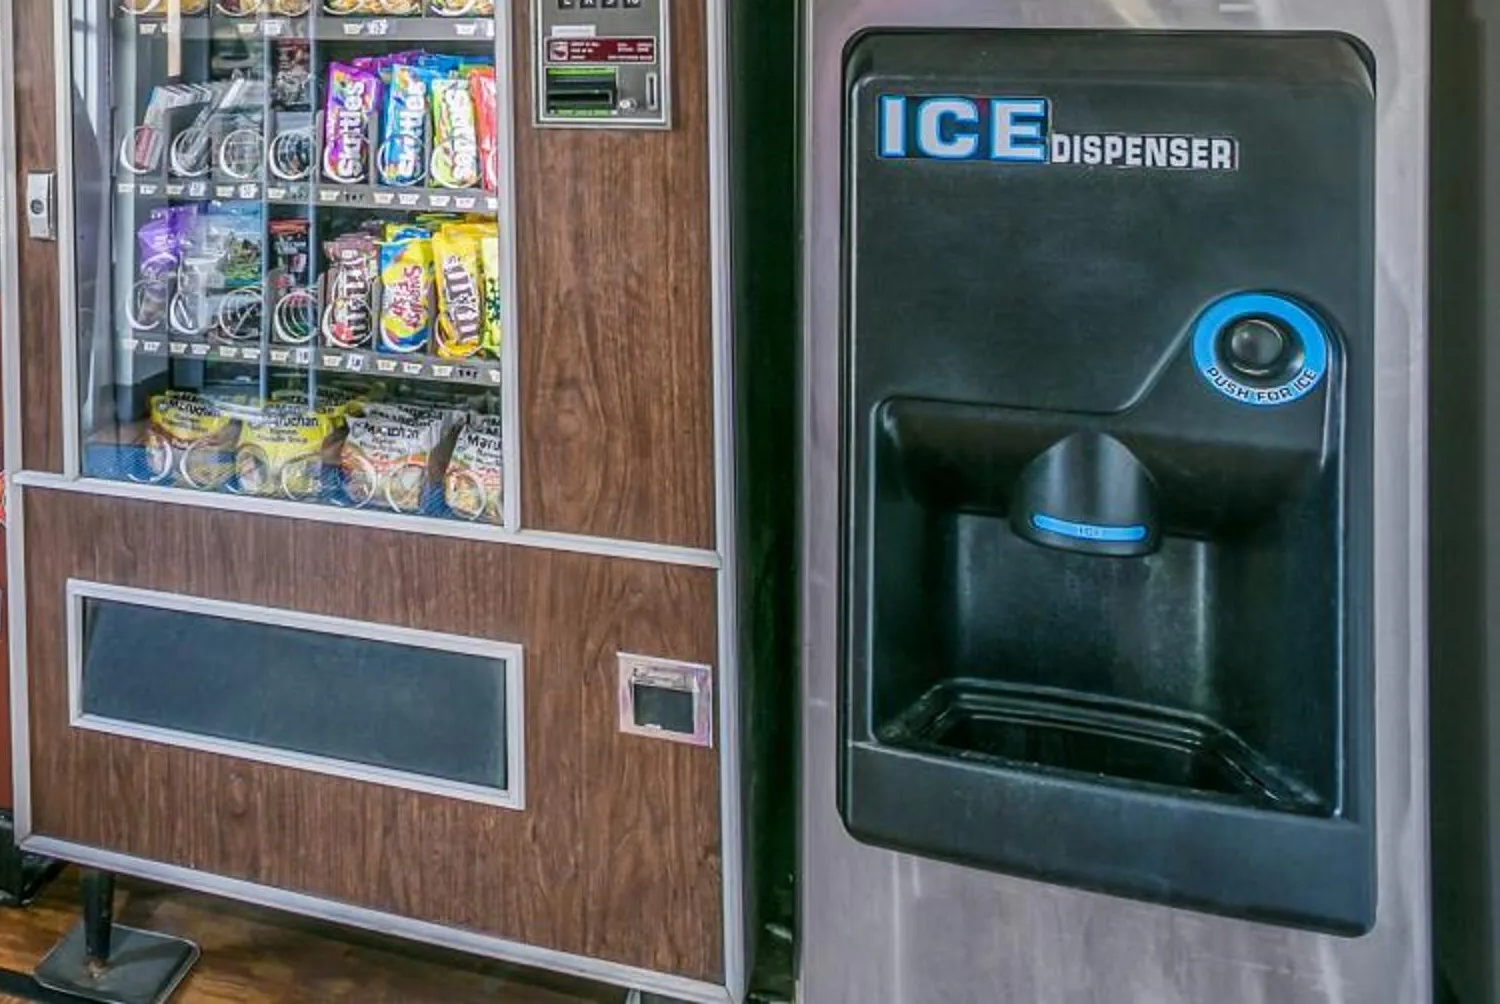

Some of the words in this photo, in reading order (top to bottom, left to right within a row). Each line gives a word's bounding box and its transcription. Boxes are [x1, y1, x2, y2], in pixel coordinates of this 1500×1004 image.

[337, 81, 365, 177] Skittles
[881, 96, 1046, 161] ICE
[1050, 133, 1234, 170] DISPENSER
[1206, 367, 1249, 399] PUSH
[1257, 387, 1293, 401] FOR
[1293, 369, 1317, 391] ICE
[467, 434, 501, 450] Maru
